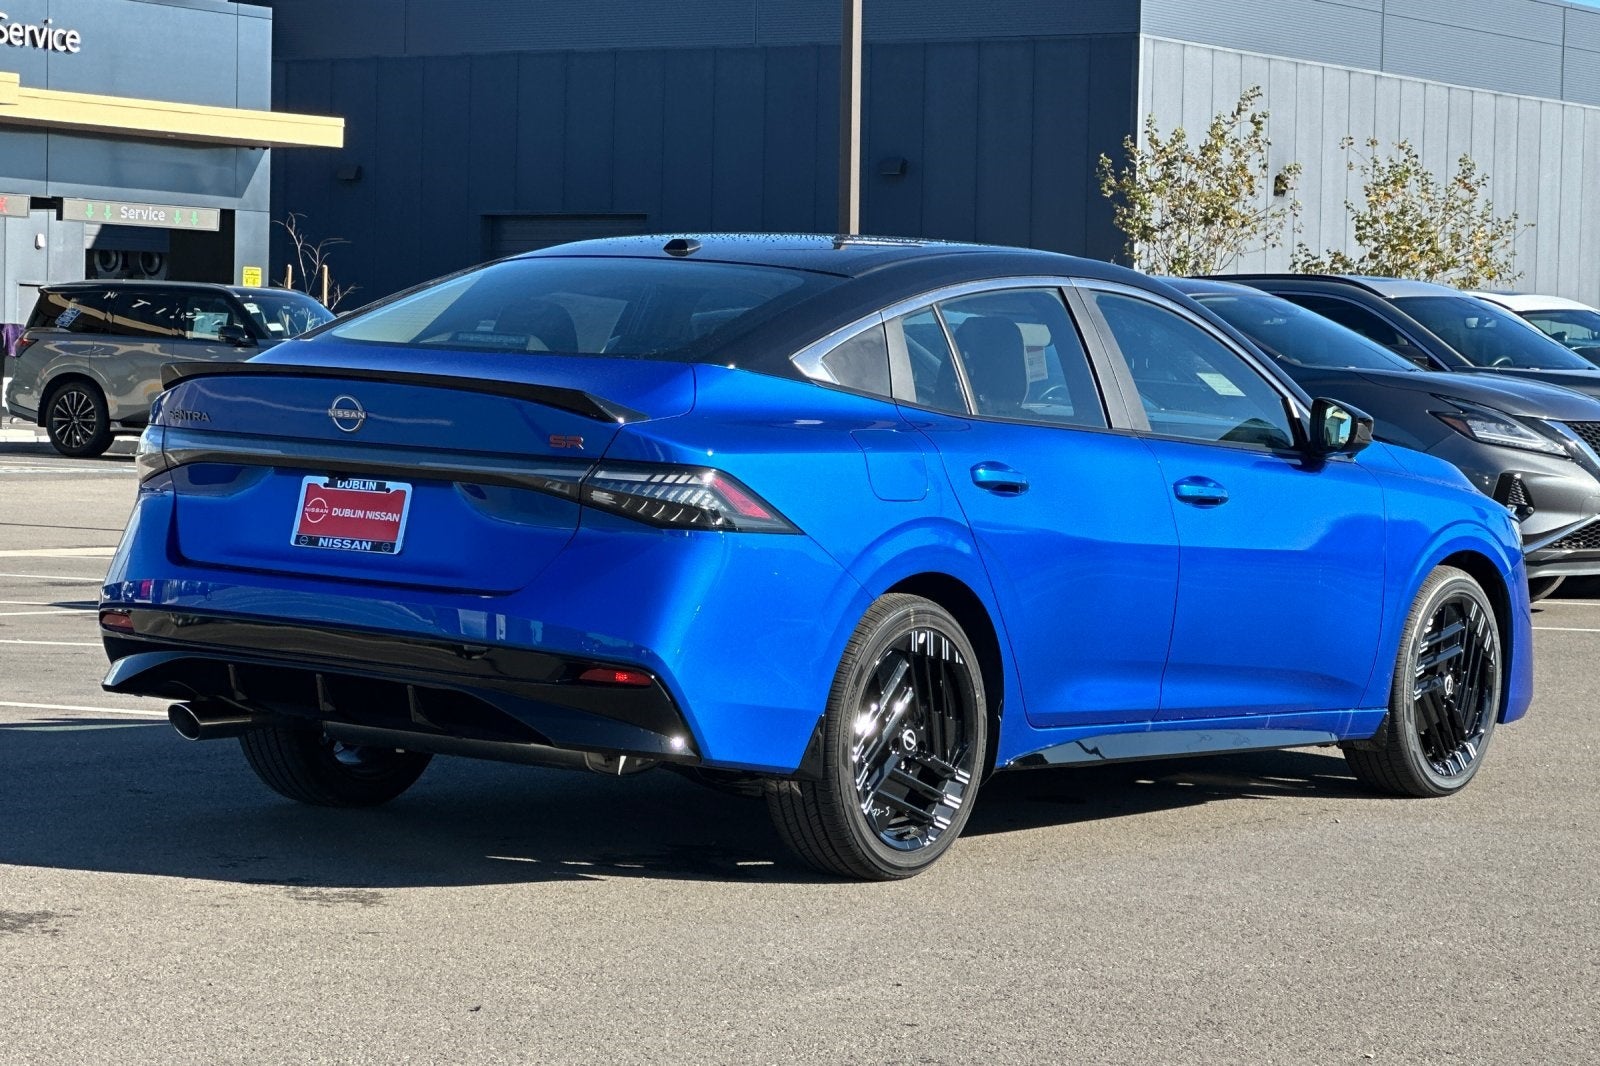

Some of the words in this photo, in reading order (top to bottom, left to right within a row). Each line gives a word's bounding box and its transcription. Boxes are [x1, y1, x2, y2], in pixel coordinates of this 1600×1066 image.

[0, 11, 81, 53] Service
[120, 205, 166, 221] Service
[169, 409, 212, 423] SENTRA
[328, 409, 366, 419] NISSAN
[549, 434, 584, 450] SR
[336, 480, 377, 491] DUBLIN
[331, 507, 365, 519] DUBLIN
[365, 511, 401, 522] NISSAN
[318, 537, 372, 551] NISSAN
